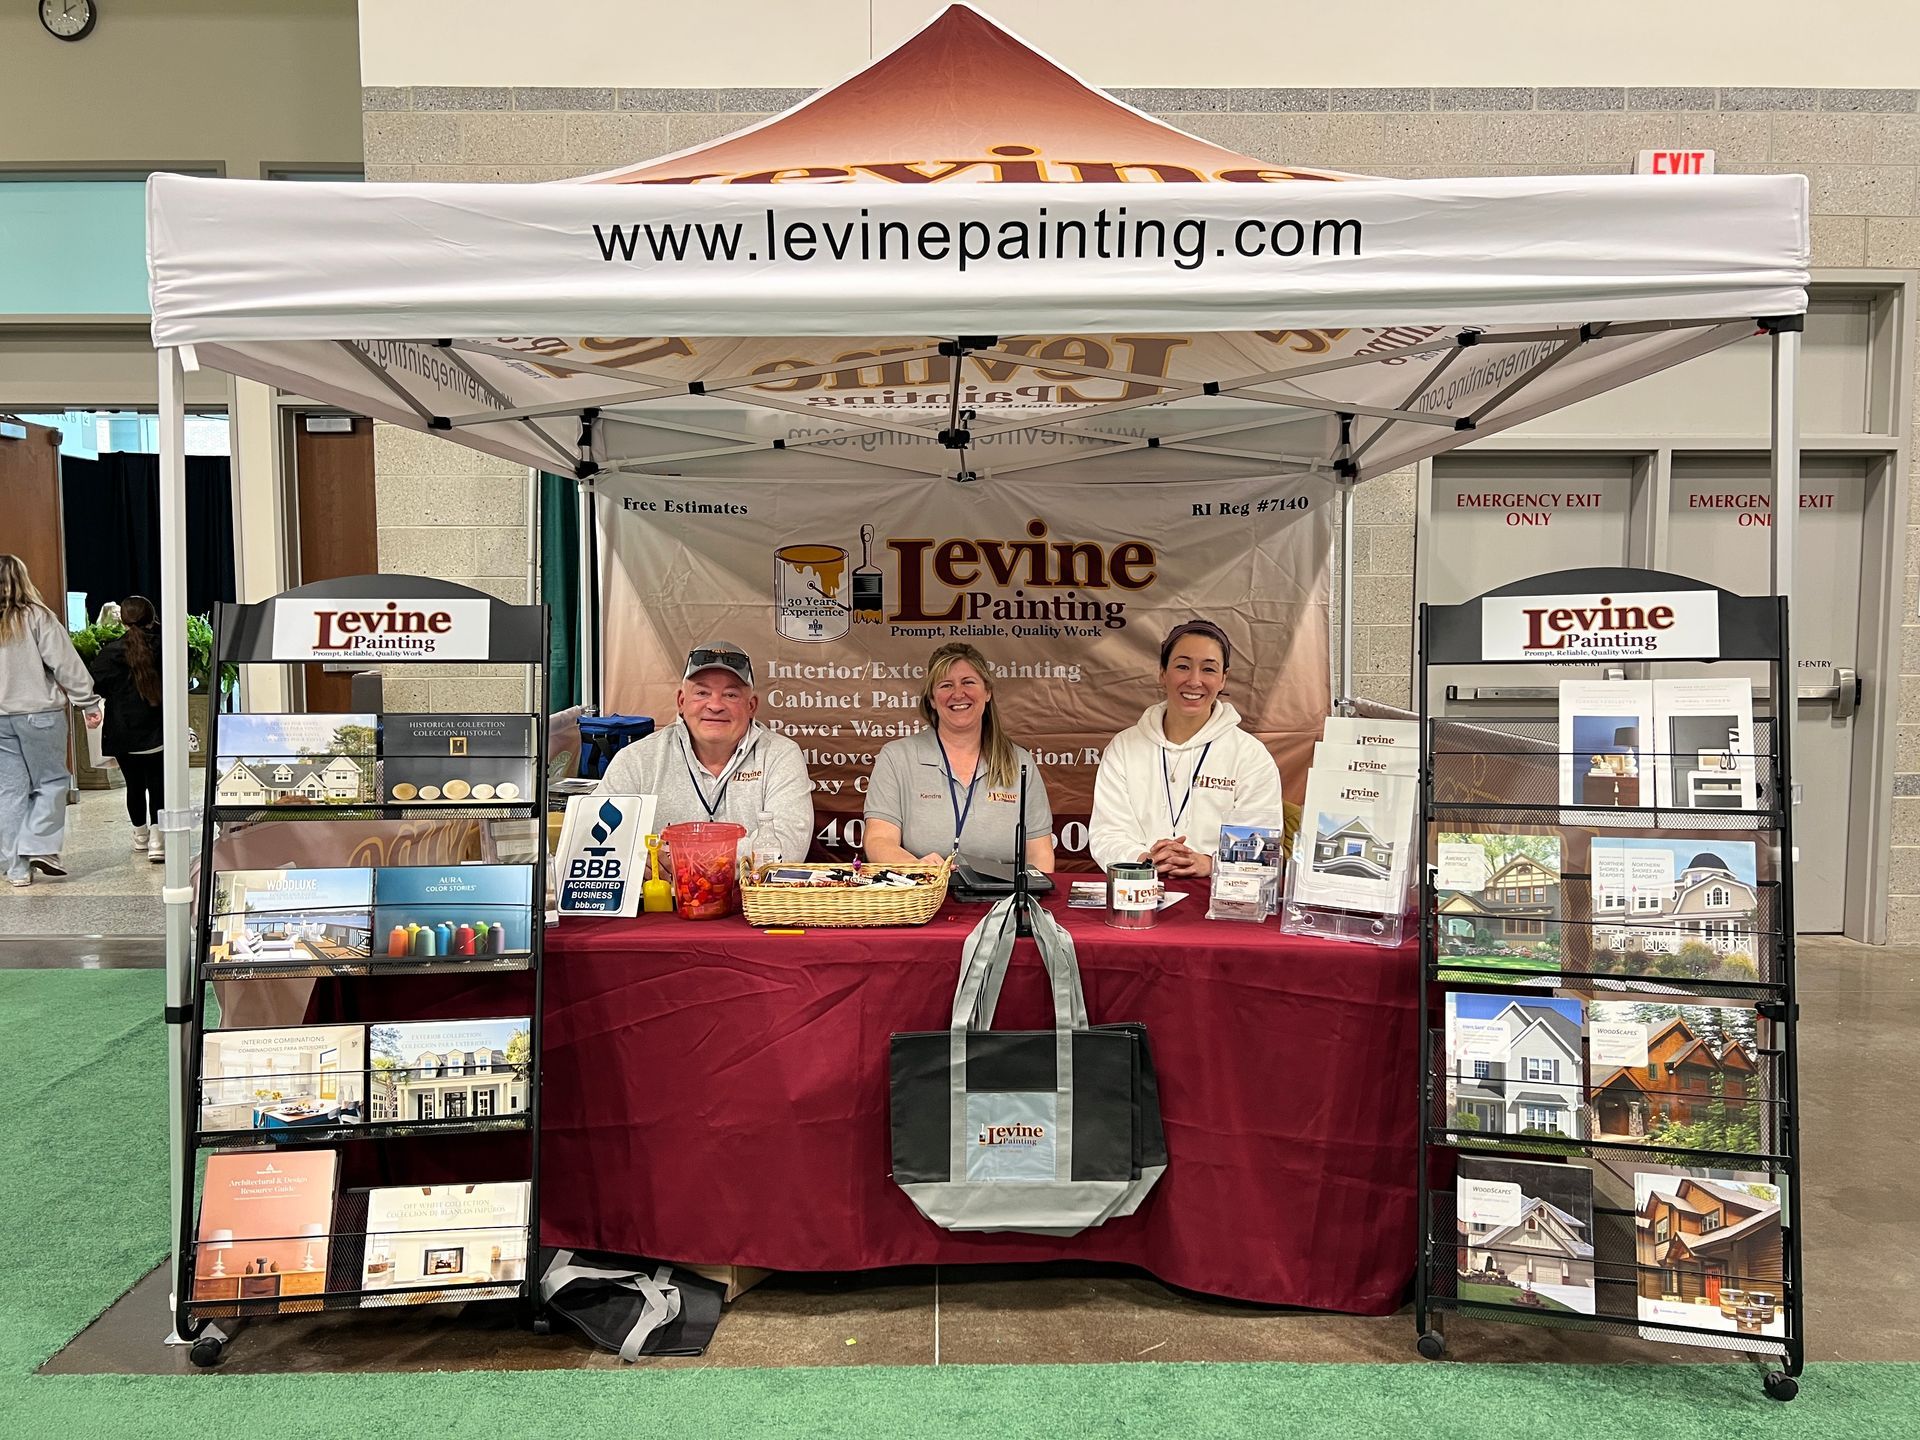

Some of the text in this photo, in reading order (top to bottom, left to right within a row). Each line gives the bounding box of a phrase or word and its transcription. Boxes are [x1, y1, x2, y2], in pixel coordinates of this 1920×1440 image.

[592, 207, 1363, 271] www.levinepainting.com
[623, 497, 748, 515] Free Estimates
[1191, 496, 1309, 517] RI Reg #7140
[1457, 494, 1602, 507] EMERGENCY EXIT
[1689, 494, 1835, 508] EMERGEN EXIT
[1506, 511, 1552, 526] ONLY
[886, 518, 1158, 625] Levine
[788, 597, 838, 607] 30 Years
[782, 607, 844, 618] Experience
[966, 590, 1127, 629] Painting
[312, 602, 452, 650] Levine
[1523, 597, 1675, 650] Levine
[890, 624, 1102, 639] Prompt, Reliable, Quality Work
[354, 635, 435, 652] Painting
[1566, 632, 1657, 651] Painting
[1524, 648, 1644, 658] Prompt, Reliable, Quality Work
[768, 658, 928, 680] Interior/Exte
[1797, 660, 1831, 668] E-ENTRY
[768, 690, 861, 708] Cabinet
[769, 719, 930, 737] Power Washi
[1361, 734, 1395, 745] Levine
[1353, 760, 1387, 772] Levine
[1205, 776, 1236, 789] Levine
[1345, 788, 1380, 800] Levine
[569, 859, 621, 879] BBB
[266, 879, 317, 891] WOODLUXE
[567, 881, 621, 890] ACCREDITED
[571, 891, 613, 899] BUSINESS
[574, 901, 606, 910] bbb.org
[274, 1036, 325, 1044] COMBINATIONS
[987, 1122, 1044, 1145] Levine
[1003, 1138, 1037, 1146] Painting
[229, 1177, 275, 1187] Architectural
[240, 1187, 273, 1195] Resource
